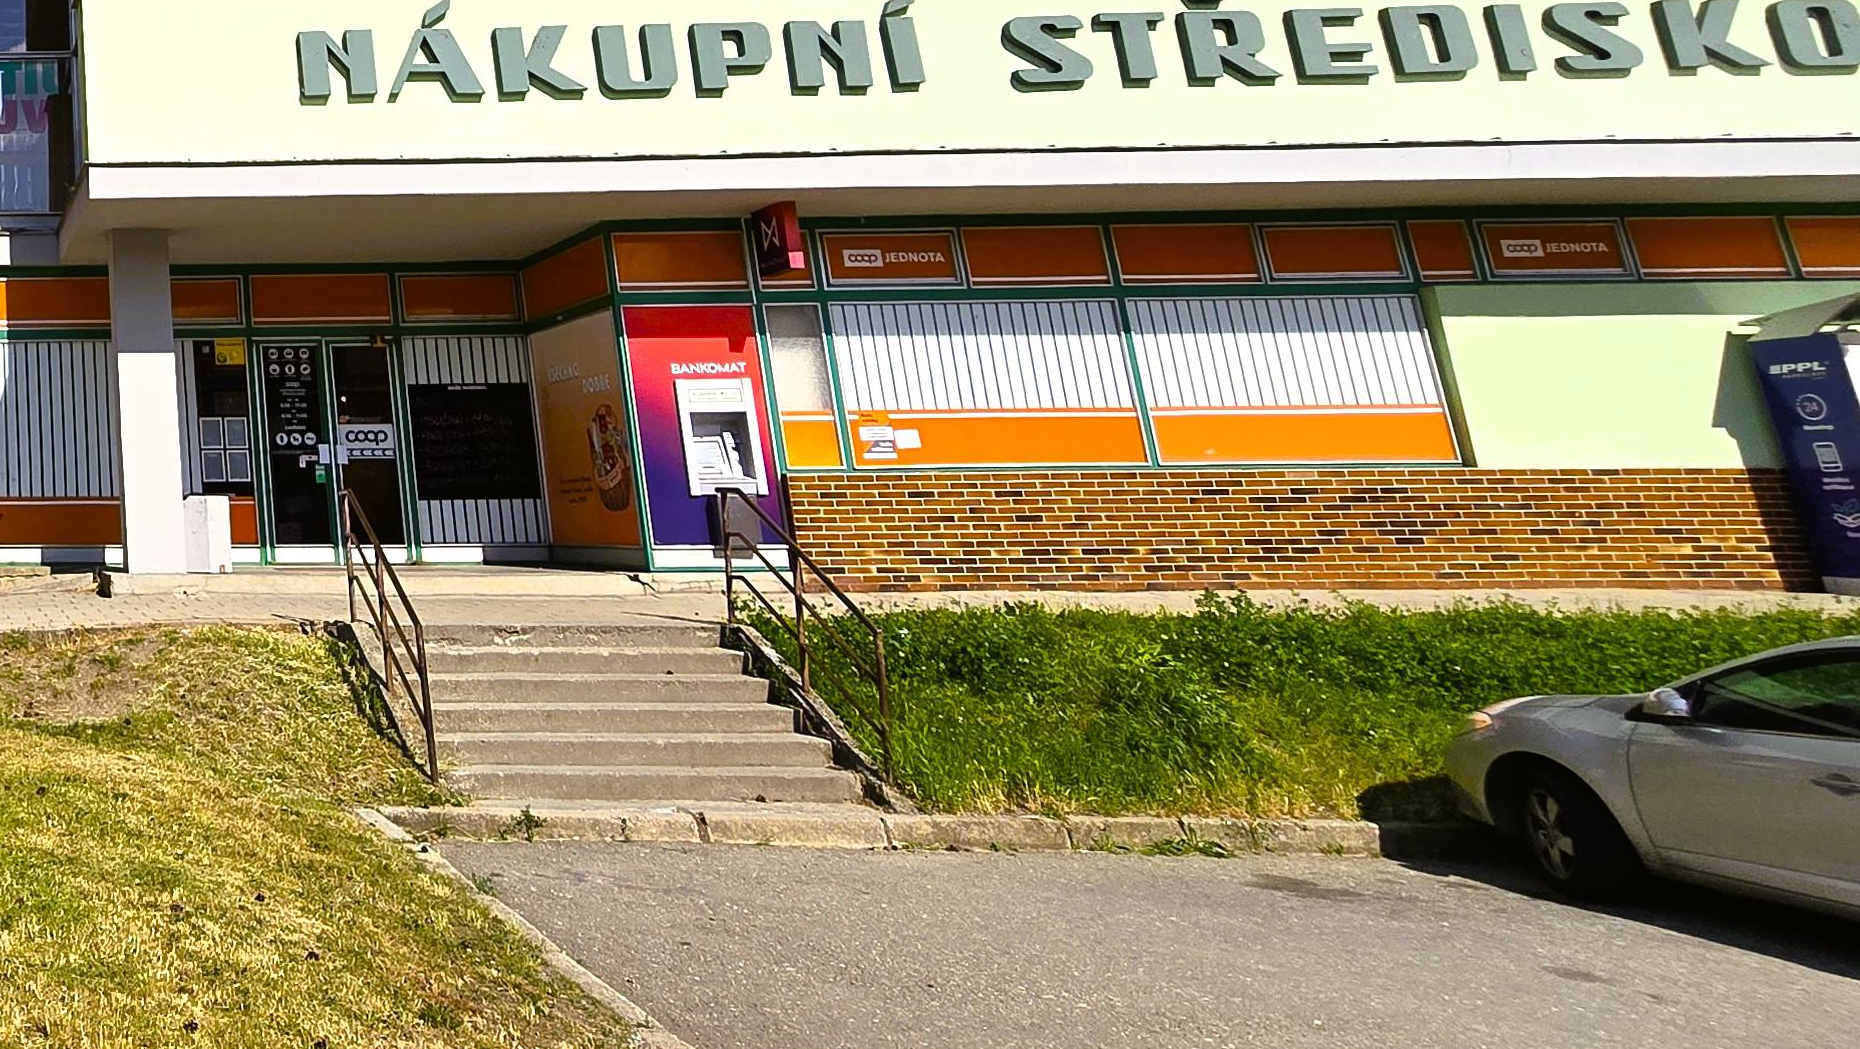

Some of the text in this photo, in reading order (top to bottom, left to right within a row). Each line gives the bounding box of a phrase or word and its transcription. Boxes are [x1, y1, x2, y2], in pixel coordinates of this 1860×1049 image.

[1507, 242, 1609, 254] coop JEDNOTA
[848, 252, 946, 265] coop JEDNOTA
[670, 361, 747, 375] BANKOMAT
[1782, 361, 1827, 374] PPL
[345, 429, 388, 446] coop
